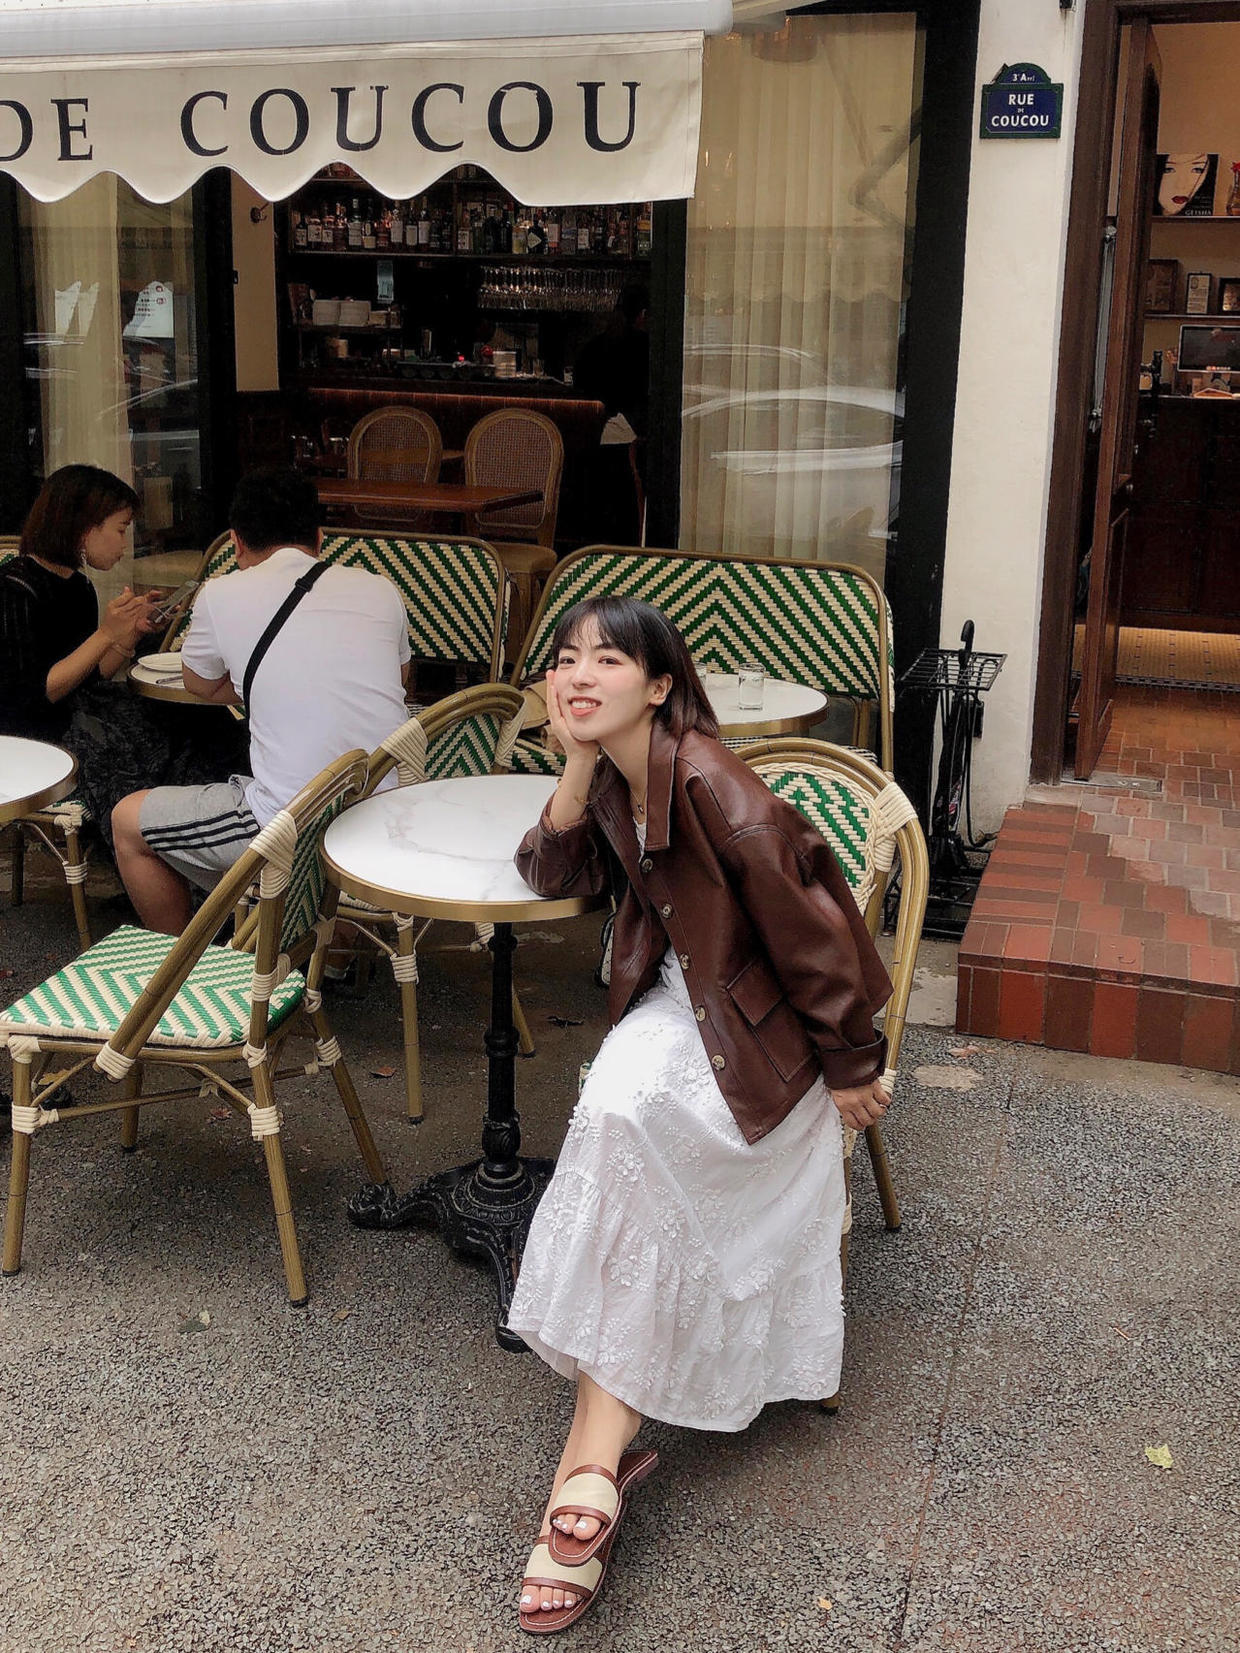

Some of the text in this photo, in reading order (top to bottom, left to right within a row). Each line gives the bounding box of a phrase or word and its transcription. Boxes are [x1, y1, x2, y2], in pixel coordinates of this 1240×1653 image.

[1008, 94, 1035, 106] RUE
[0, 82, 641, 161] DE COUCOU
[991, 115, 1049, 127] COUCOU
